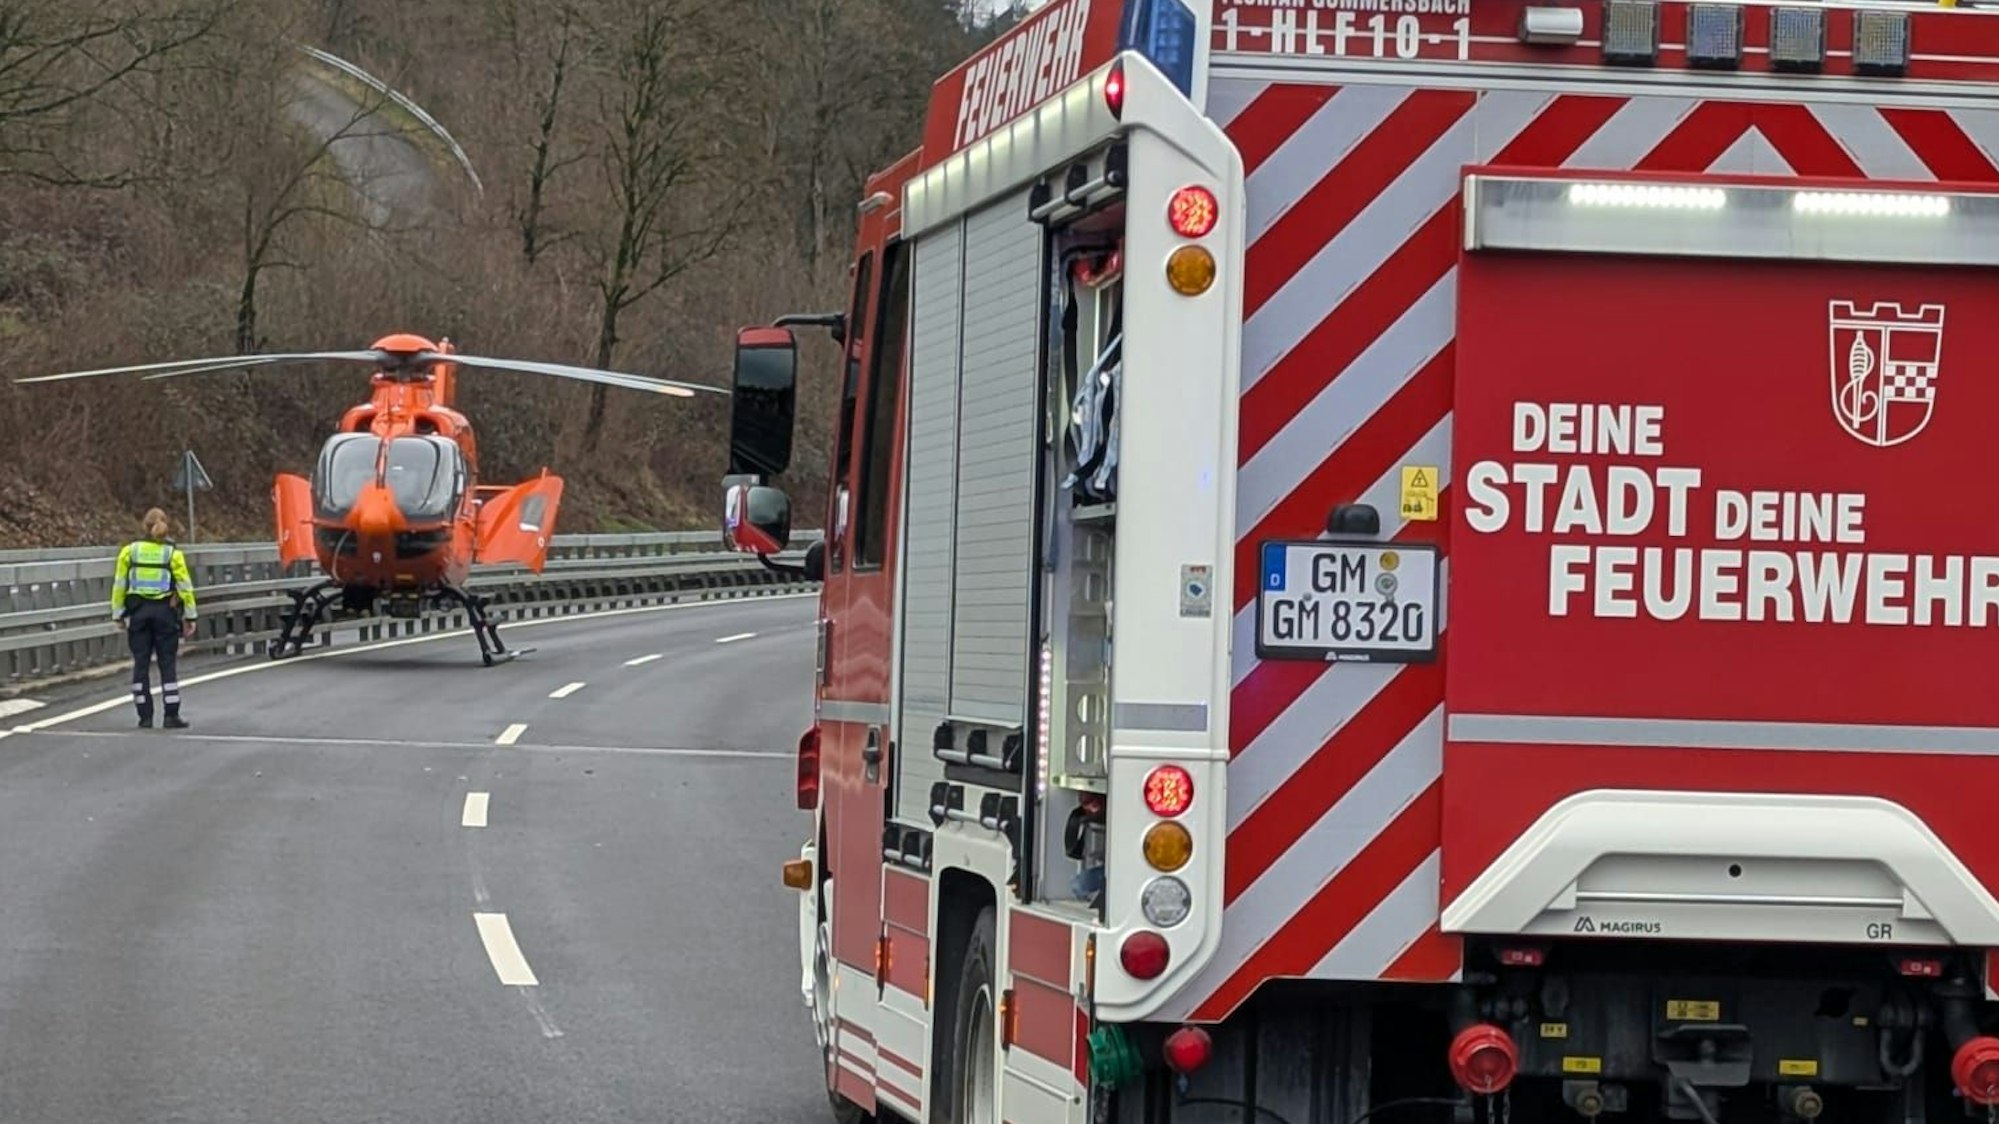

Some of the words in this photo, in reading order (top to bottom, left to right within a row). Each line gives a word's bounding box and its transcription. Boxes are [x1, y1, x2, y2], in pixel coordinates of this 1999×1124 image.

[953, 0, 1090, 152] FEUERWEHR
[1513, 402, 1664, 455] DEINE
[1465, 461, 1702, 536] STADT
[1715, 490, 1866, 543] DEINE
[1270, 573, 1280, 586] D
[1312, 552, 1366, 593] GM
[1549, 544, 1999, 627] FEUERWEHR
[1273, 600, 1319, 640] GM
[1331, 601, 1424, 642] 8320
[1600, 922, 1662, 933] MAGIRUS
[1867, 923, 1892, 939] GR
